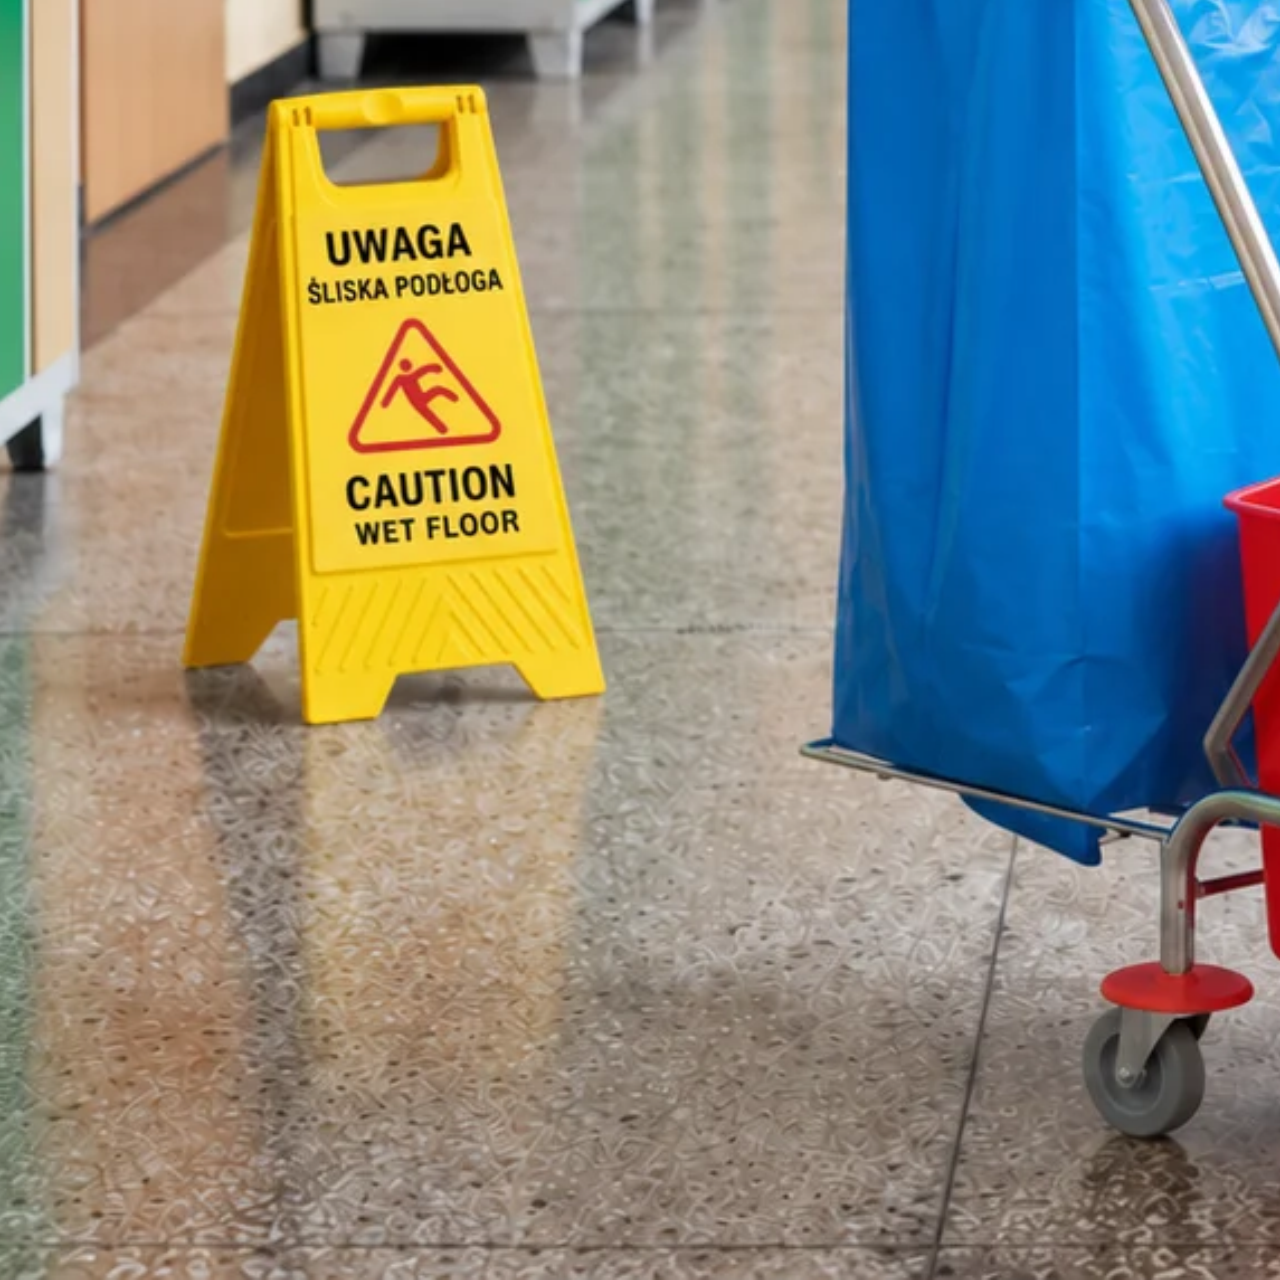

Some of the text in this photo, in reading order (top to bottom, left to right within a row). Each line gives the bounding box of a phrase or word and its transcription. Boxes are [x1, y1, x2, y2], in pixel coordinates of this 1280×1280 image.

[326, 222, 472, 266] UWAGA
[307, 268, 504, 305] ŚLISKA PODŁOGA
[346, 463, 516, 511] CAUTION
[355, 509, 520, 546] WET FLOOR
